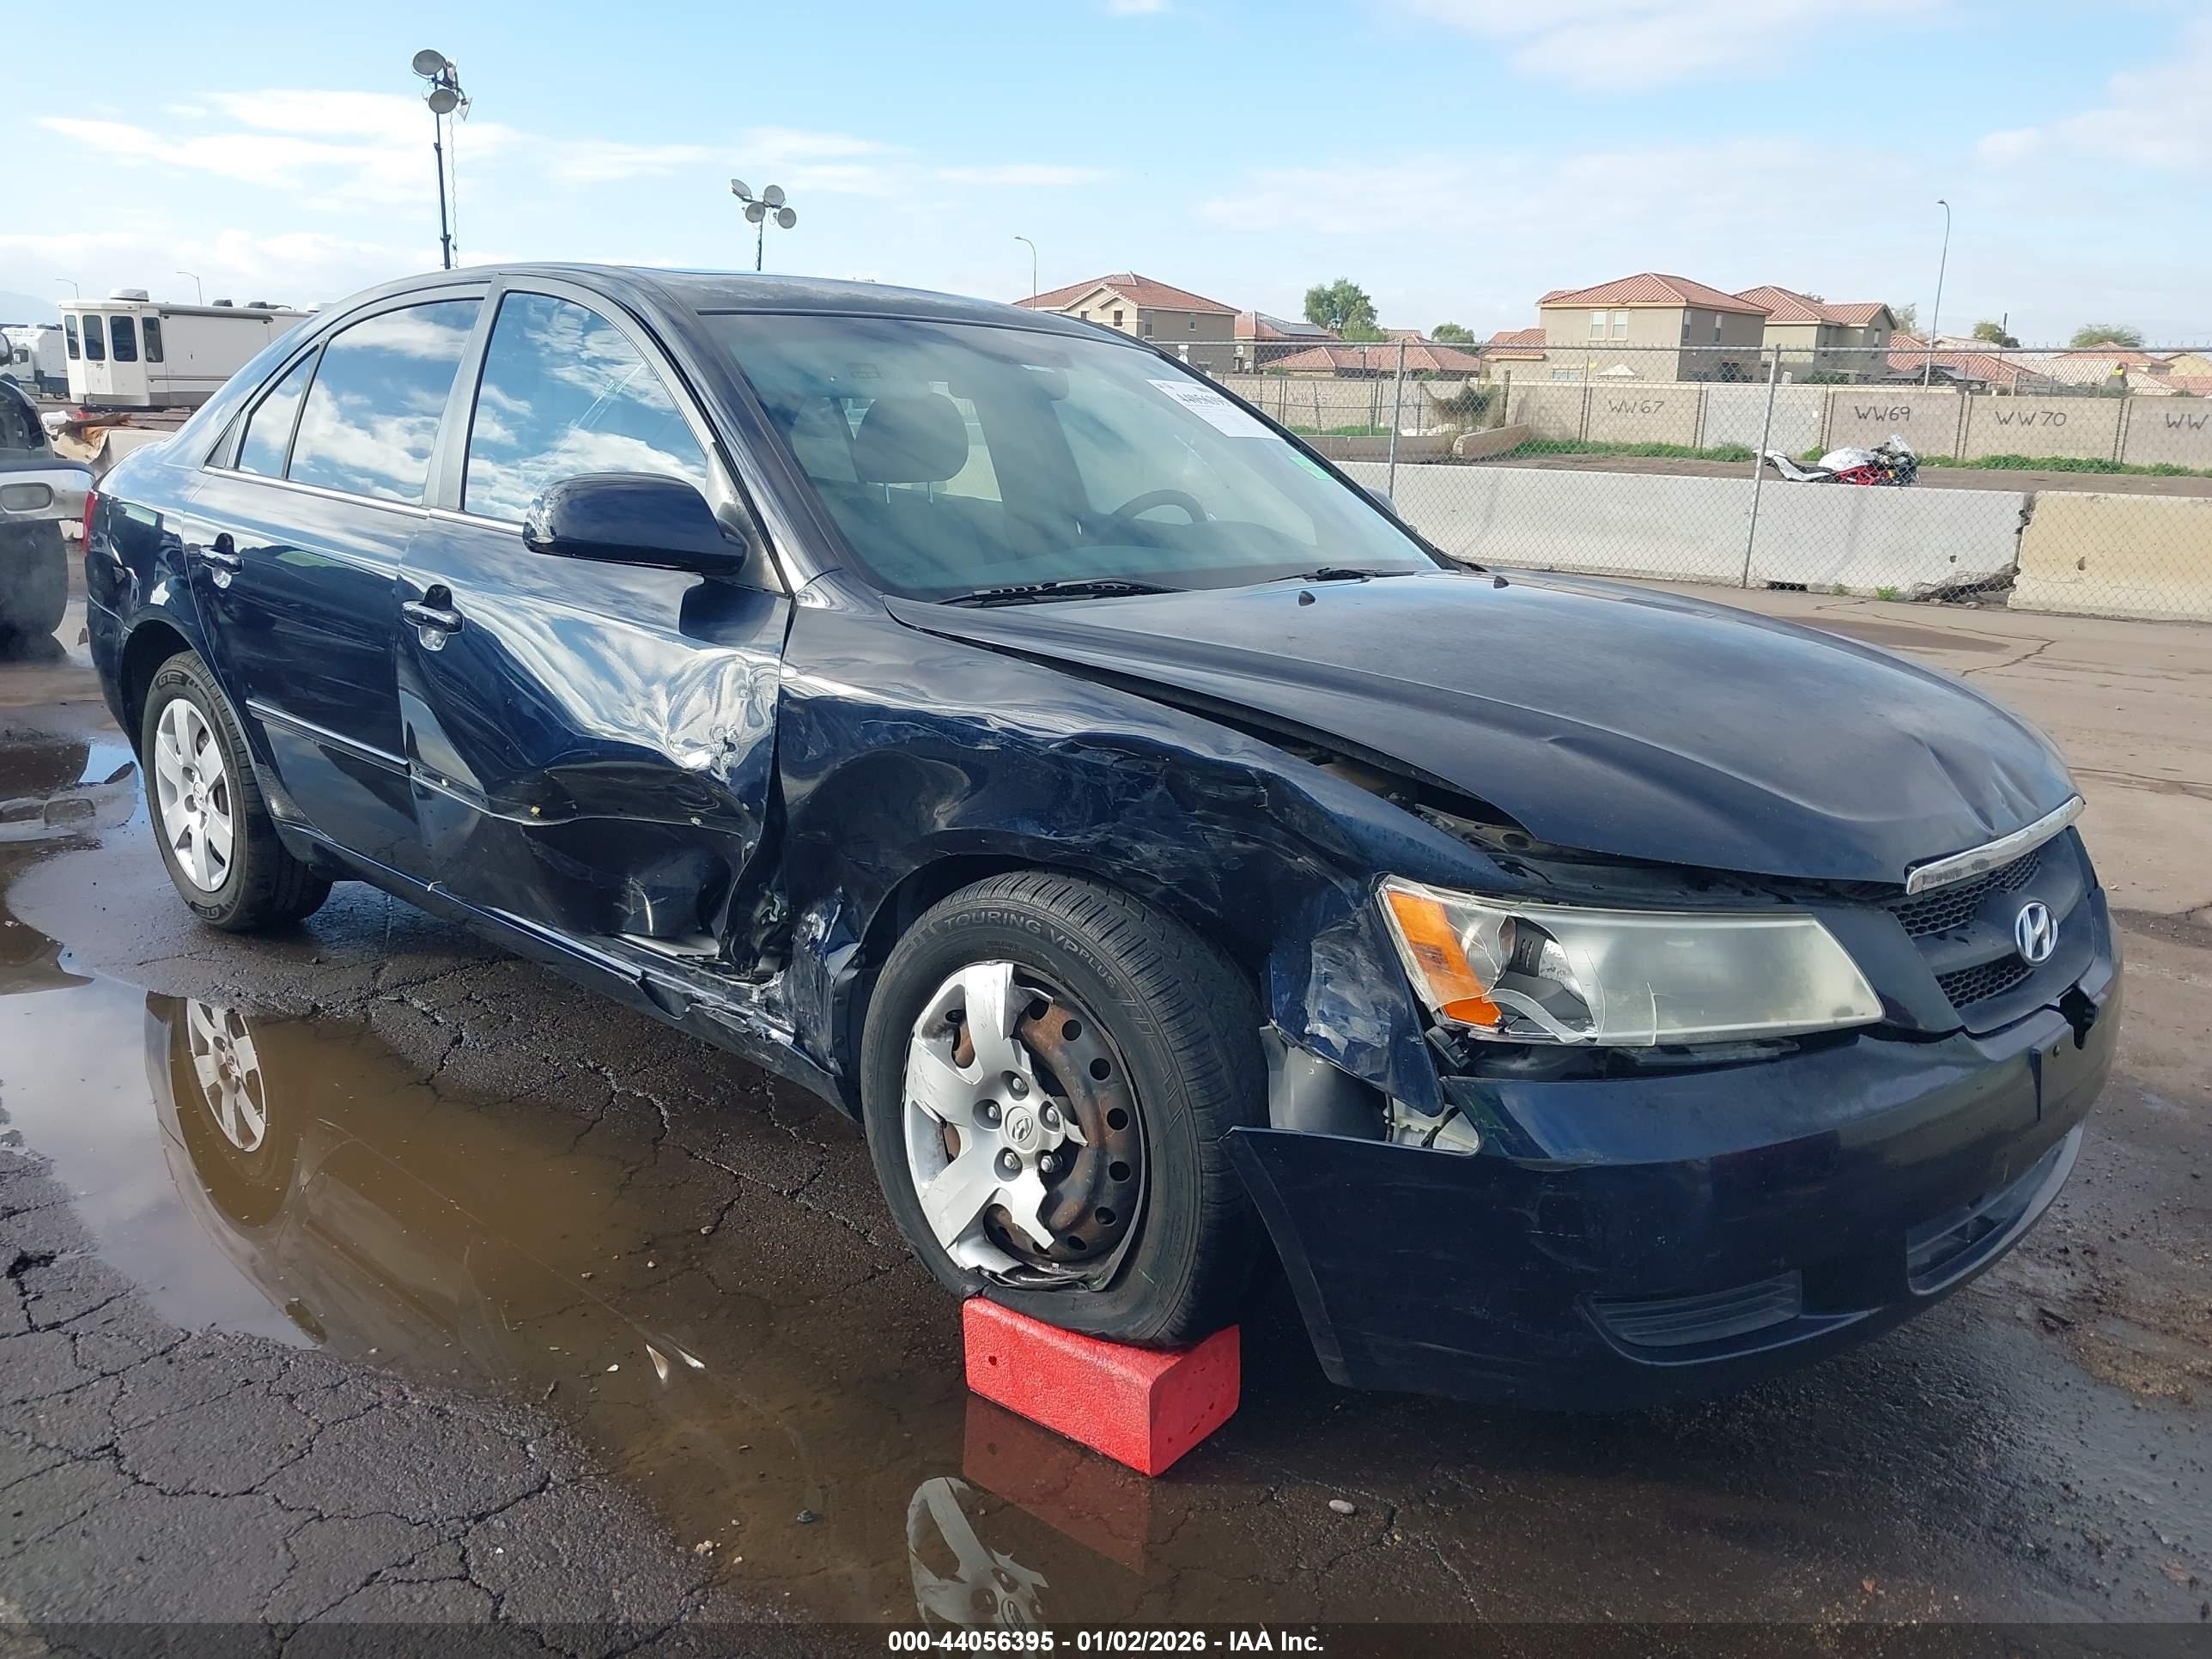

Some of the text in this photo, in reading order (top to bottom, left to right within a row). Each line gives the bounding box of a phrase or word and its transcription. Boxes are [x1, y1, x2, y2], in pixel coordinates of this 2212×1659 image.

[1855, 405, 1911, 422] WW69
[1995, 410, 2067, 427] WW70
[945, 911, 1042, 934] TOURING
